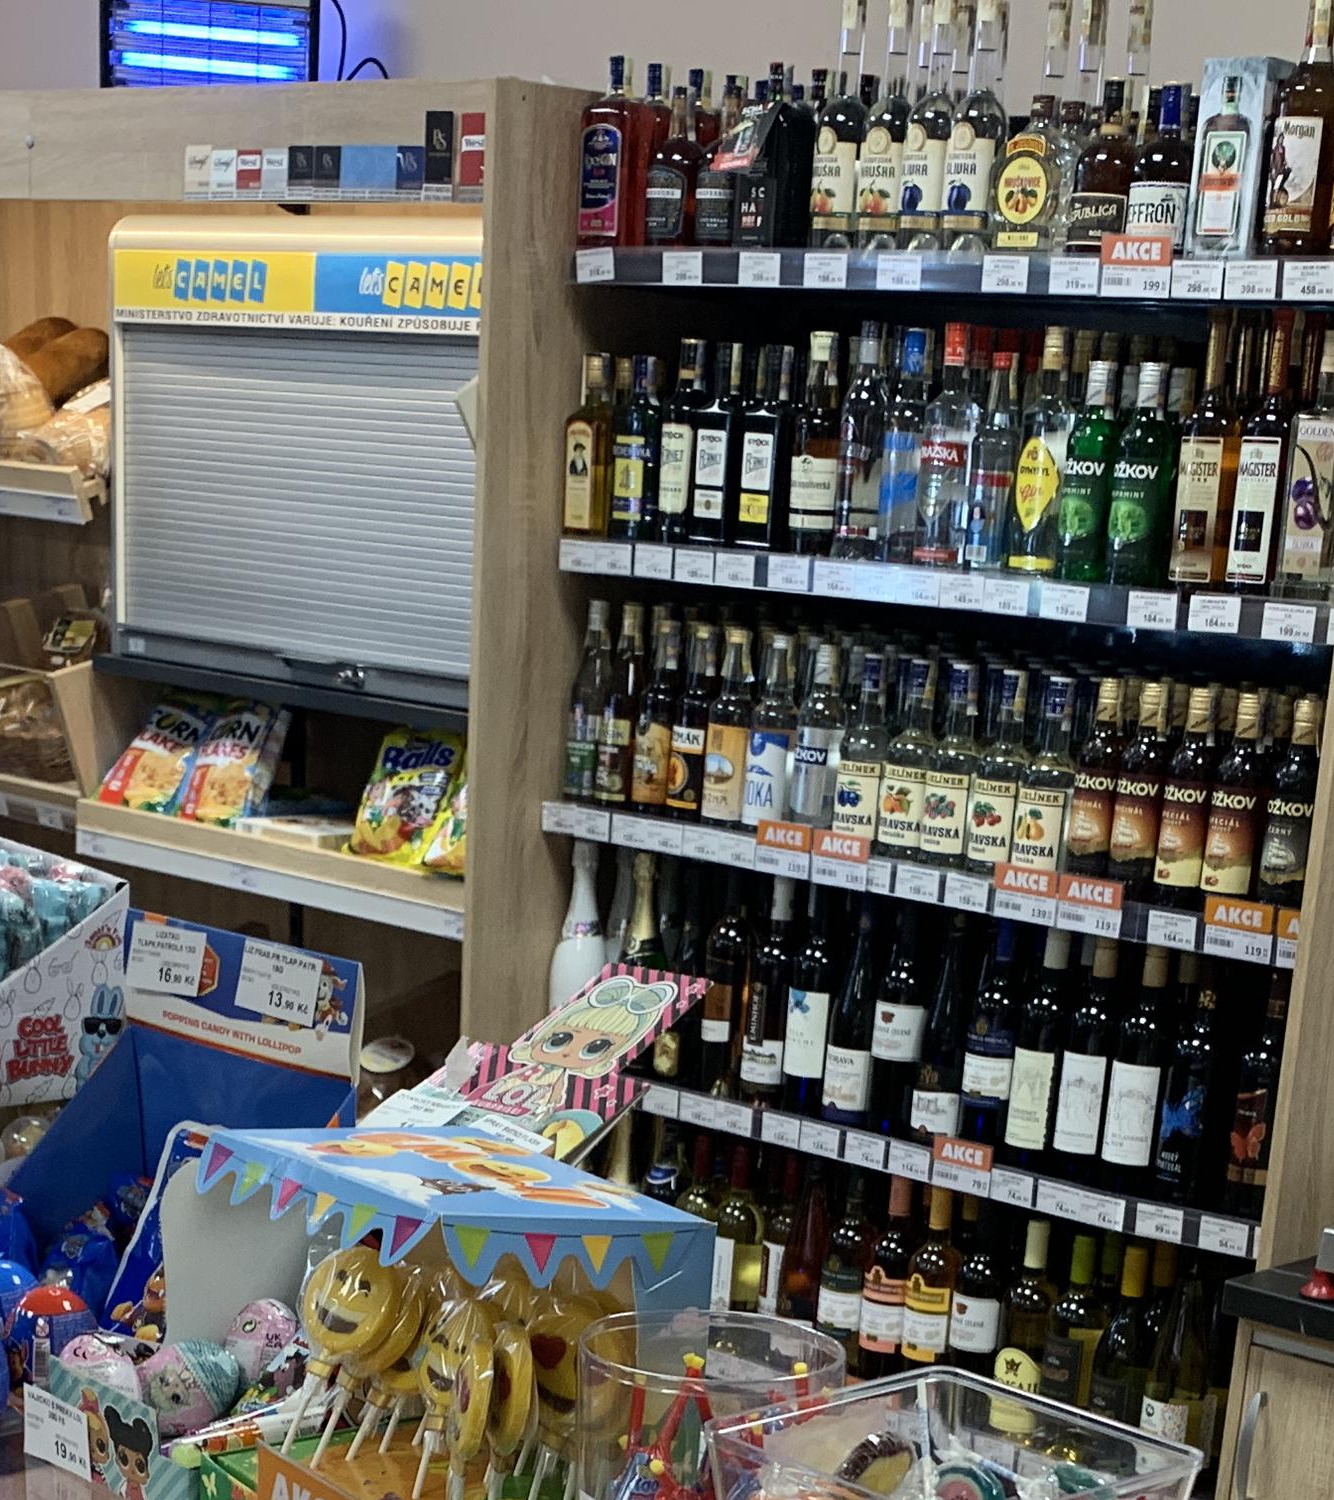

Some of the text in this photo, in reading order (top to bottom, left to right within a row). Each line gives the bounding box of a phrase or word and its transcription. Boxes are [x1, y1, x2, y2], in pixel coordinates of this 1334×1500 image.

[1284, 121, 1316, 139] Morgan
[1111, 240, 1161, 262] AKCE
[176, 270, 263, 292] CAMEL
[388, 276, 482, 299] CAME
[1143, 279, 1161, 291] 199
[116, 309, 193, 322] MINISTERSTVO
[197, 310, 285, 325] ZDRAVOTNICTVÍ
[340, 315, 393, 330] KOUŘENÍ
[397, 317, 472, 332] ZPŮSOBUJE
[1181, 459, 1218, 478] MAGISTER
[1240, 460, 1277, 479] MAGISTER
[765, 827, 803, 847] AKCE
[821, 836, 860, 857] AKCE
[1003, 869, 1049, 893] AKCE
[1067, 883, 1114, 905] AKCE
[1214, 904, 1263, 929] AKCE
[17, 1014, 65, 1039] COOL
[162, 1008, 303, 1056] POPPING CANDY WITH LOLLIPOP
[13, 1033, 70, 1060] LITTLE
[6, 1054, 75, 1085] BUNNY
[941, 1143, 984, 1165] AKCE
